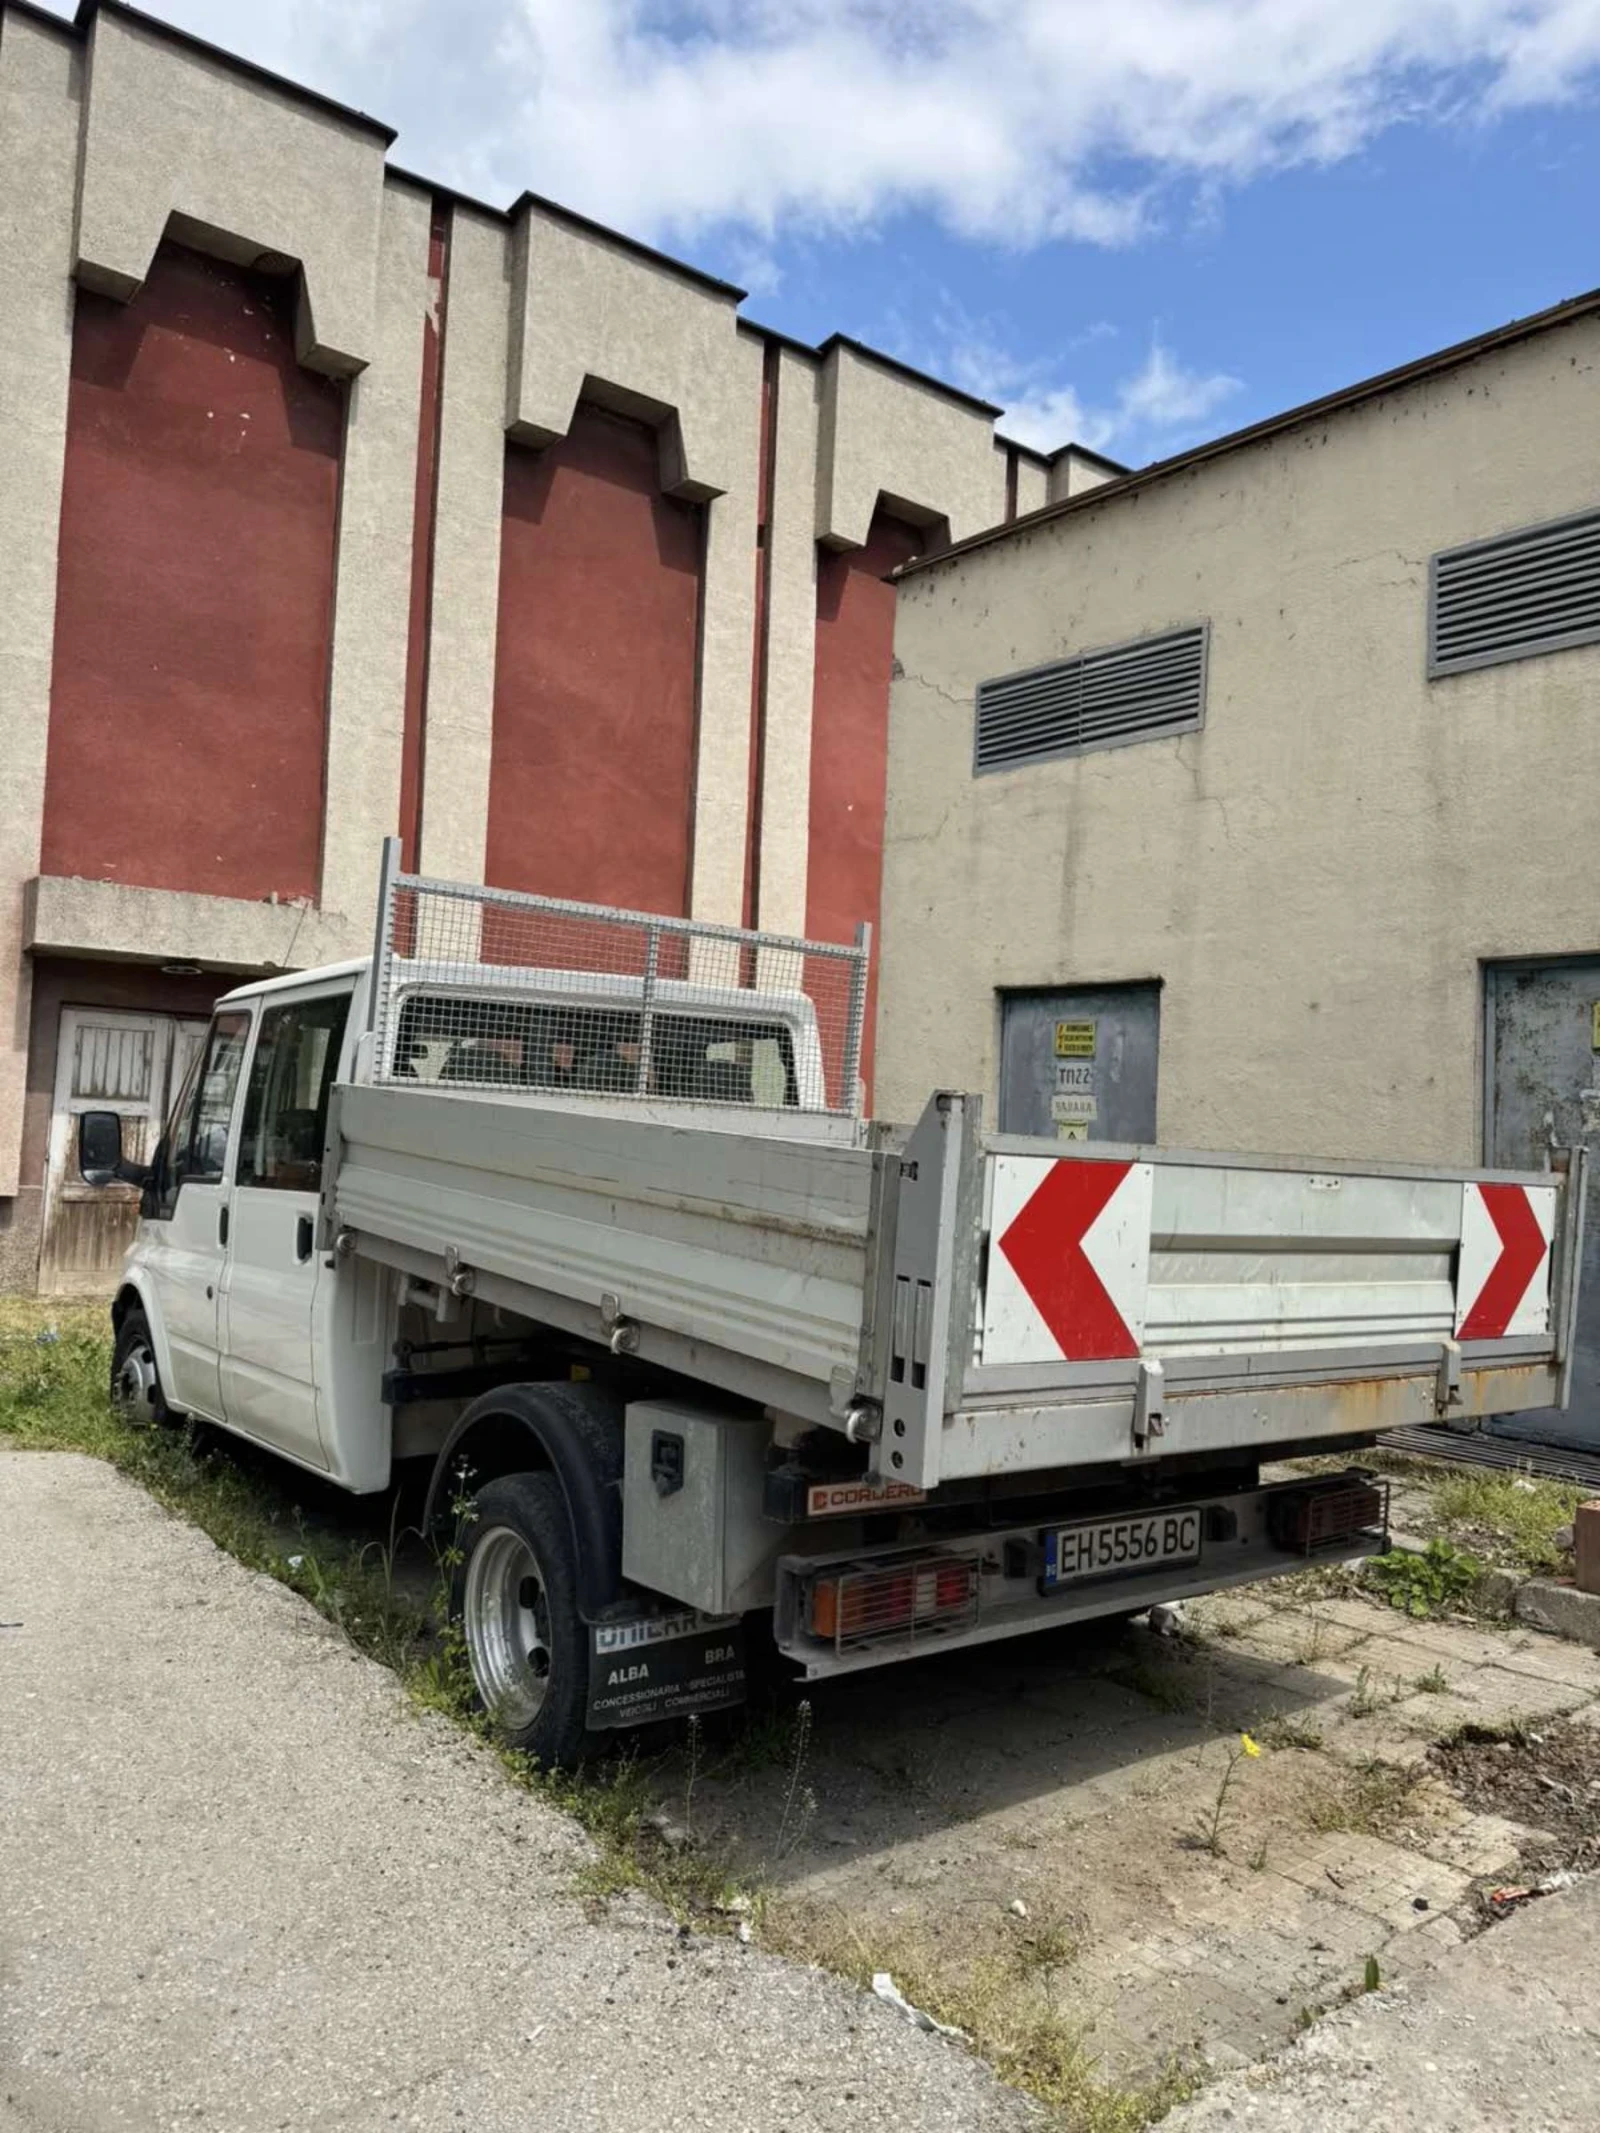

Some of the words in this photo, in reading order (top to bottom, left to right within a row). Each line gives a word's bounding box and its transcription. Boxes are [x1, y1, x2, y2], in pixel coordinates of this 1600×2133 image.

[1098, 1522, 1158, 1566] 5556
[607, 1663, 650, 1686] ALBA
[704, 1644, 736, 1665] BRA
